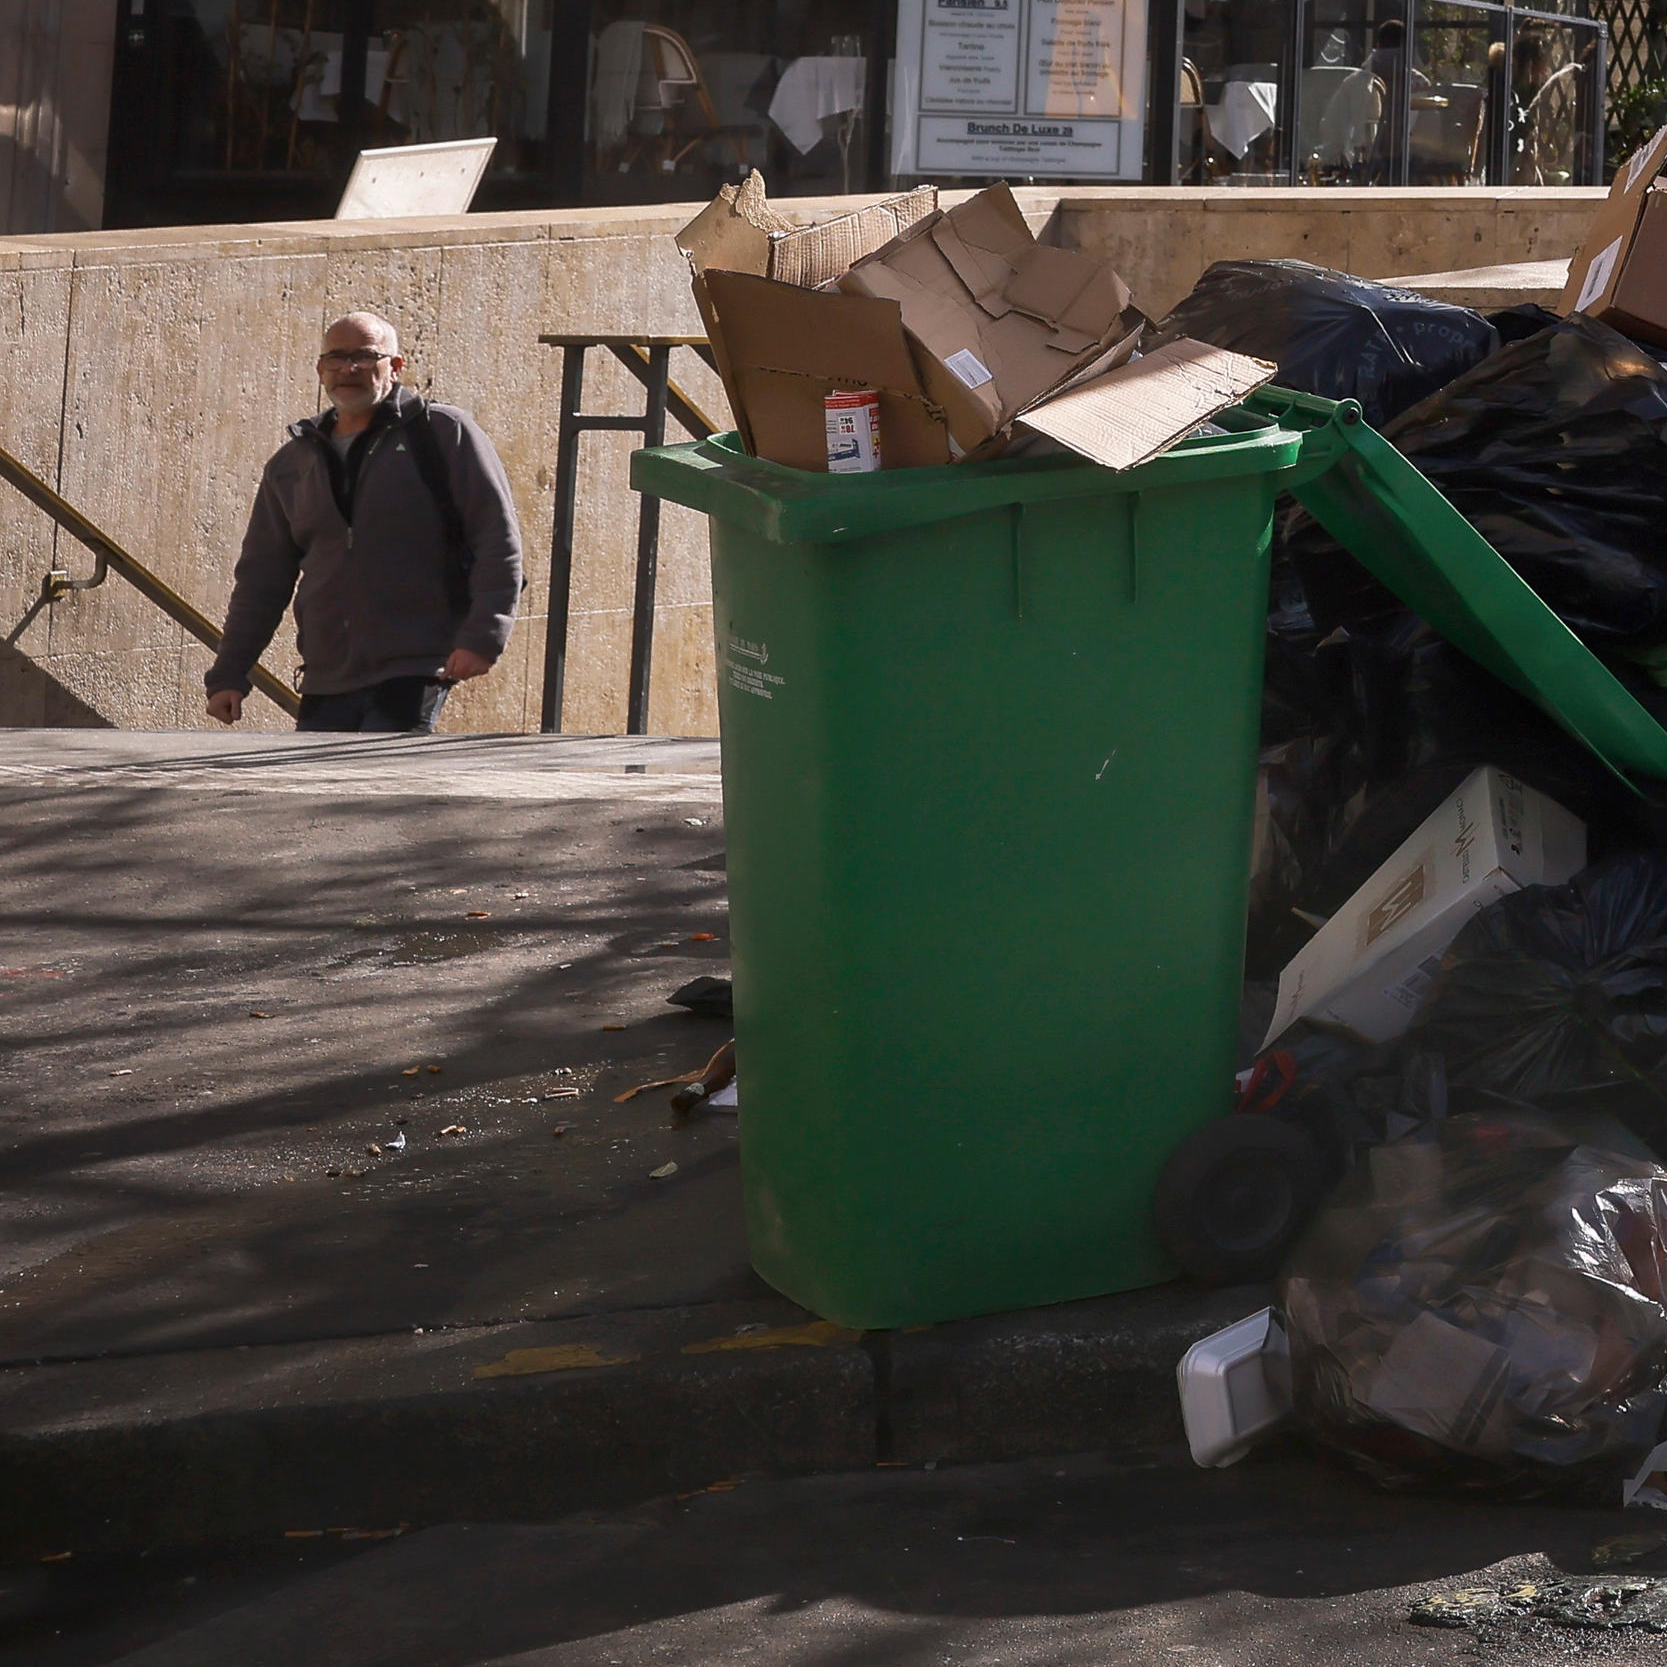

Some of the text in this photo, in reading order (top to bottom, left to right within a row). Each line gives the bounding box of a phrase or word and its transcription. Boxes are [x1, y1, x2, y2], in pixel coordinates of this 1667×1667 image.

[967, 122, 1009, 134] Brunch
[1013, 123, 1028, 134] De
[1031, 124, 1058, 135] Luxe
